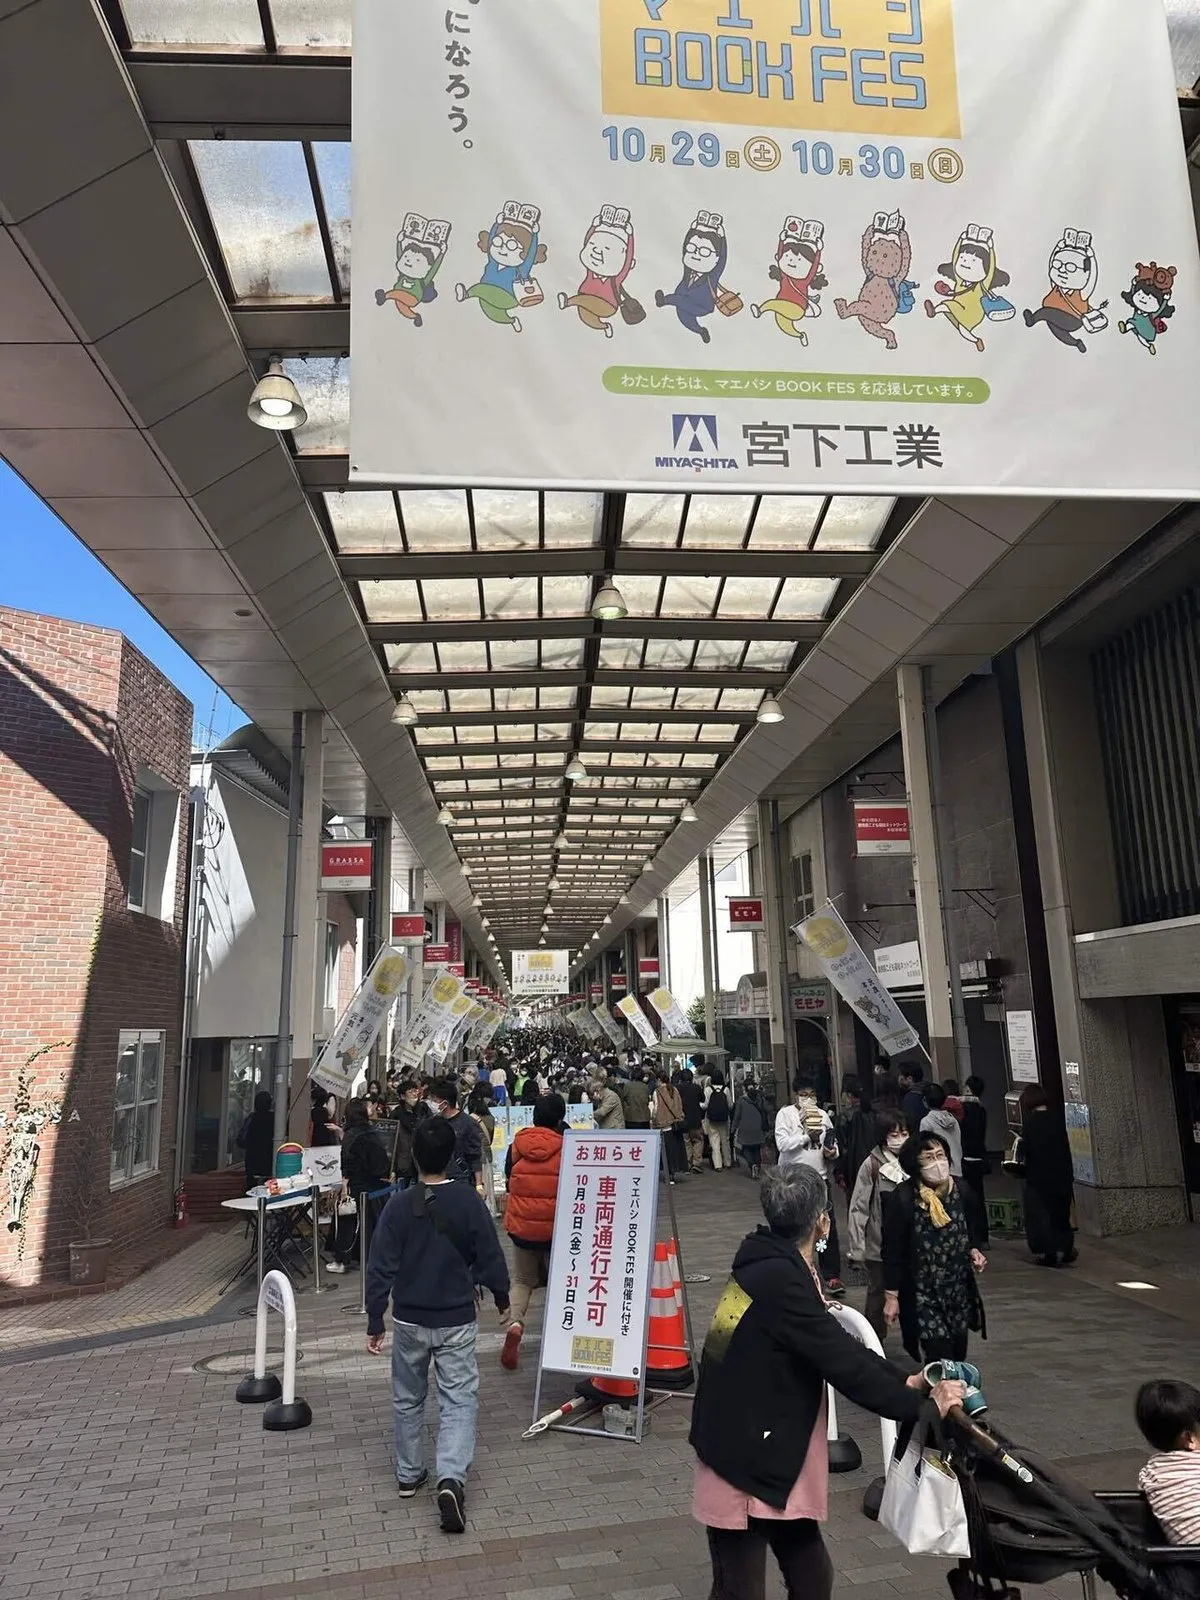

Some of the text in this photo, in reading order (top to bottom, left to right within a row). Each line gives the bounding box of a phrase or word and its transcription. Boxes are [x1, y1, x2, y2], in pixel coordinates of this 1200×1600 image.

[445, 0, 480, 149] になろう。
[634, 27, 928, 110] BOOK FES
[776, 380, 823, 393] BOOK
[827, 382, 856, 394] FES
[655, 456, 739, 470] MIYASHITA
[742, 421, 944, 470] 宮下工業
[576, 1145, 642, 1161] お知らせ
[587, 1176, 617, 1327] 車両通行不可
[621, 1177, 641, 1336] マエバシ BOOK FES 開催に付き
